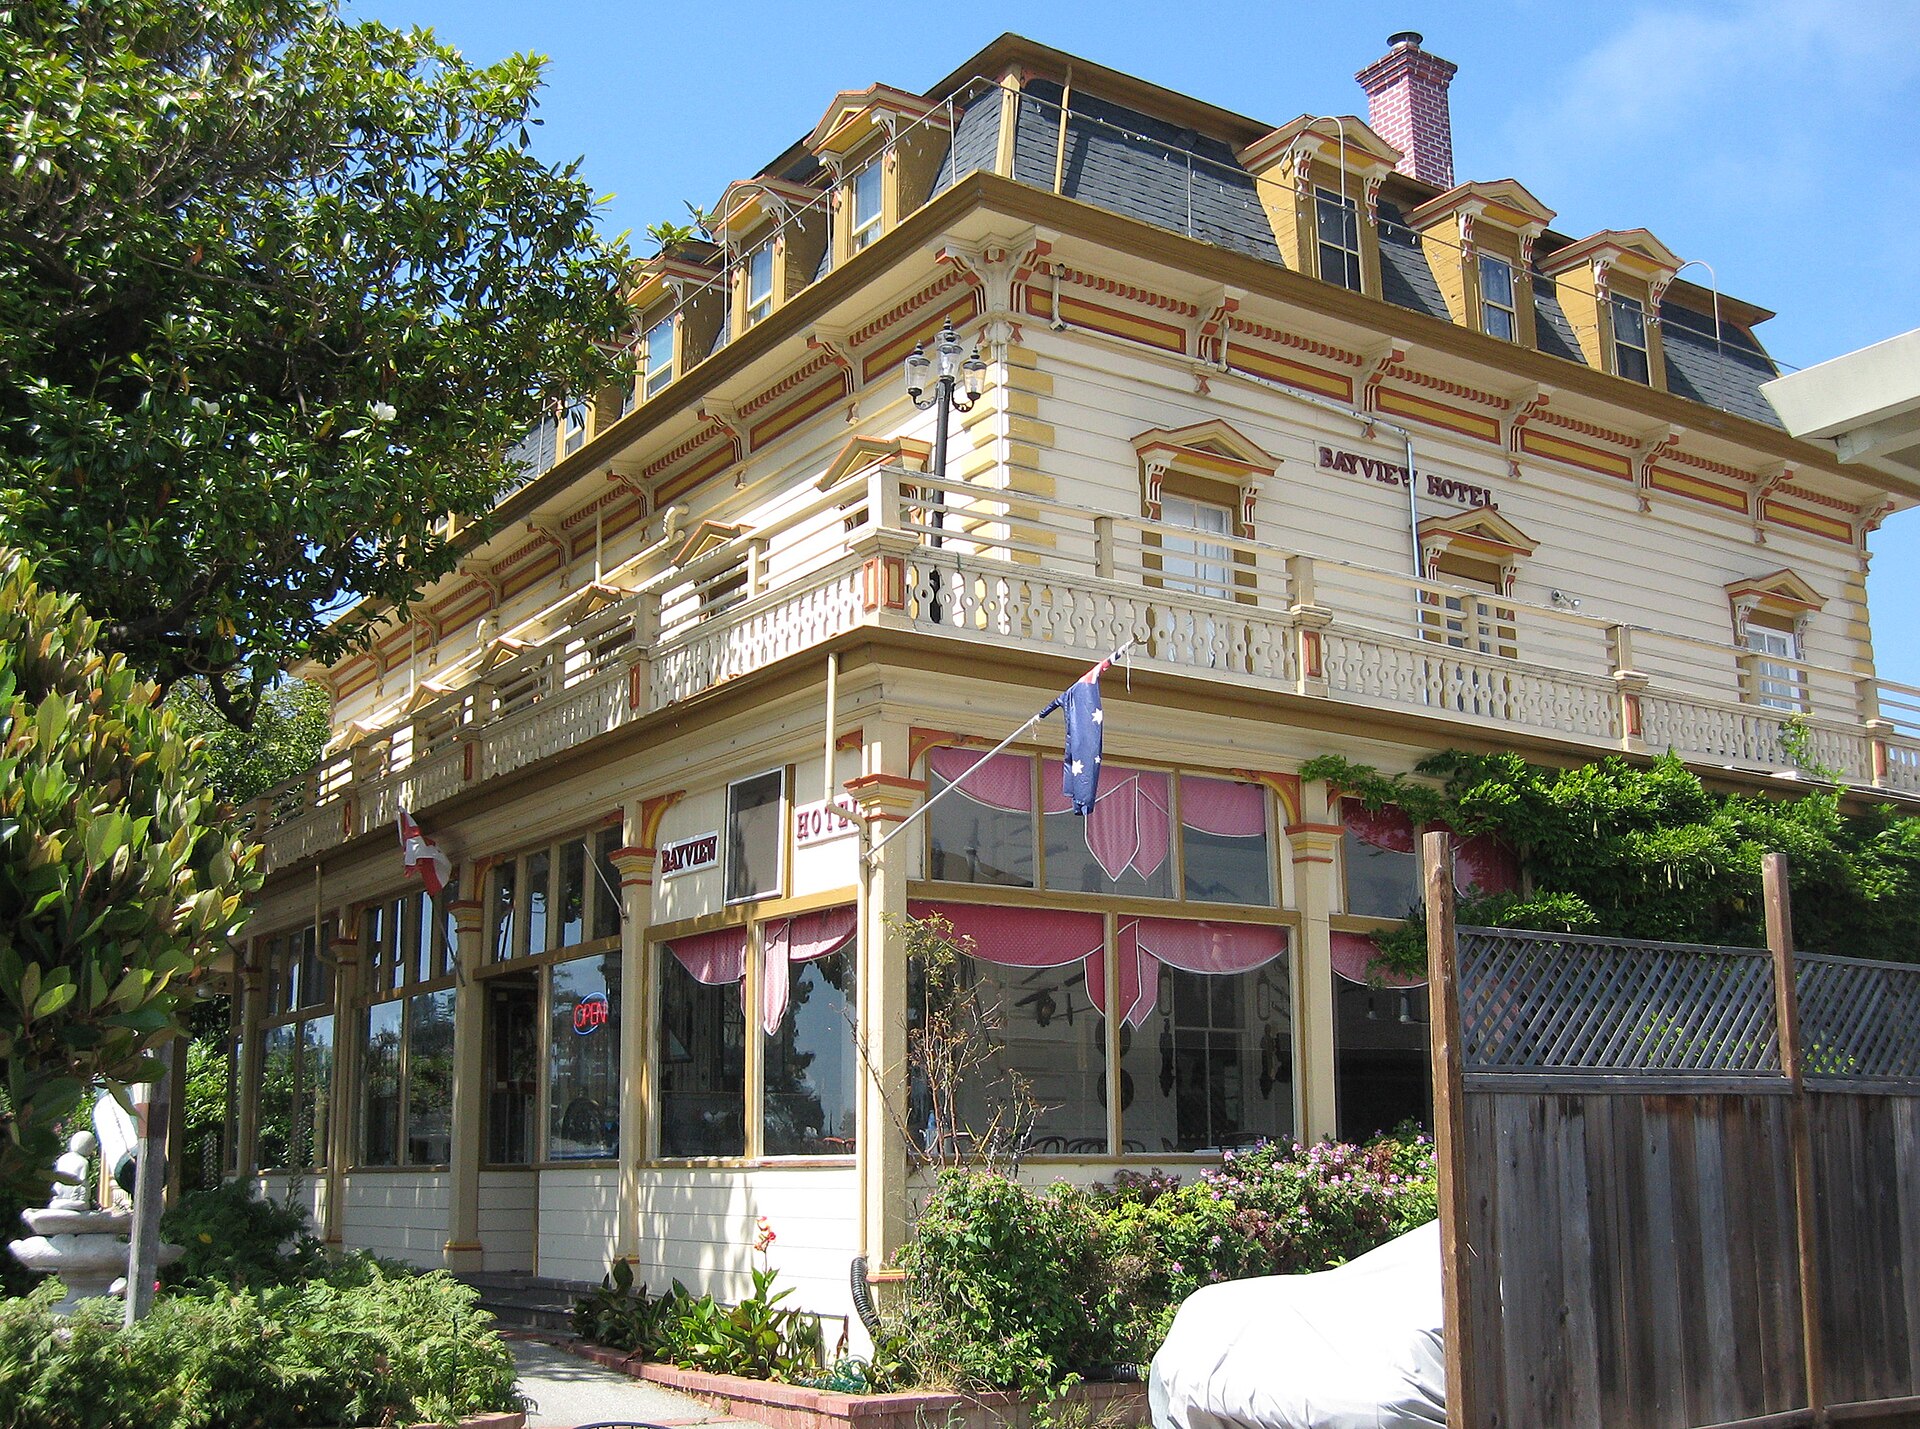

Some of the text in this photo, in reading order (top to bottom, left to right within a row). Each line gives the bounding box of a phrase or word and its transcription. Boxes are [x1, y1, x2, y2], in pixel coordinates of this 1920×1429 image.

[1318, 446, 1499, 511] BAYVIEW HOTEL
[661, 835, 718, 874] BAYVIEW
[573, 1000, 608, 1028] OPEN
